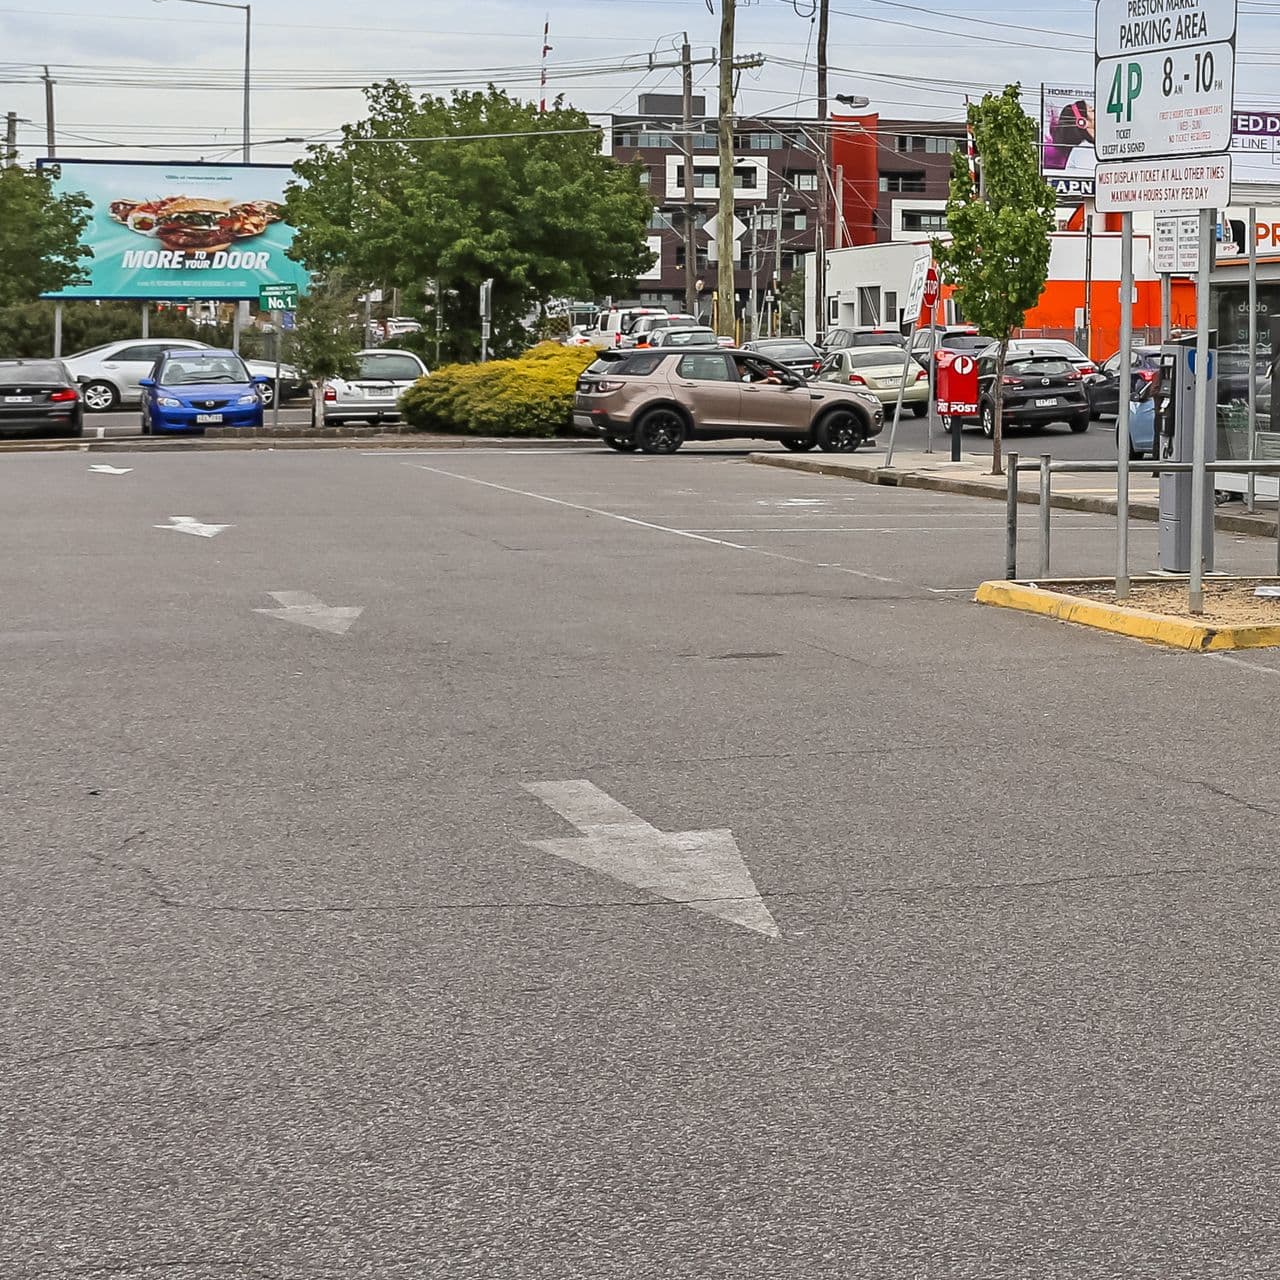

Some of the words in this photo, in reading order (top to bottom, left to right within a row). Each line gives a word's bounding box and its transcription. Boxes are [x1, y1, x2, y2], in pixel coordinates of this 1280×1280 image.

[1120, 17, 1171, 49] PARKING
[1175, 11, 1208, 41] AREA
[1106, 62, 1143, 123] 4P
[1116, 129, 1131, 139] TICKET
[1102, 144, 1119, 155] EXCEPT
[1119, 144, 1127, 154] AS
[1127, 142, 1145, 153] SIGNED
[1241, 138, 1268, 150] LINE
[1099, 172, 1114, 184] MUST
[1114, 170, 1139, 184] DISPLAY
[1140, 169, 1160, 182] TICKET
[1161, 168, 1170, 181] AT
[1170, 167, 1182, 180] ALL
[1184, 167, 1205, 180] OTHER
[1206, 166, 1225, 179] TIMES
[1056, 181, 1092, 194] APN
[1111, 190, 1137, 202] MAXIMUM
[1138, 190, 1142, 201] 4
[1143, 189, 1163, 201] HOURS
[1164, 188, 1180, 200] STAY
[1181, 187, 1194, 200] PER
[1195, 187, 1209, 200] DAY
[122, 250, 185, 269] MORE
[193, 251, 206, 260] TO
[212, 251, 270, 269] DOOR
[184, 260, 211, 269] YOUR
[924, 280, 937, 295] STOP
[950, 404, 977, 413] POST
